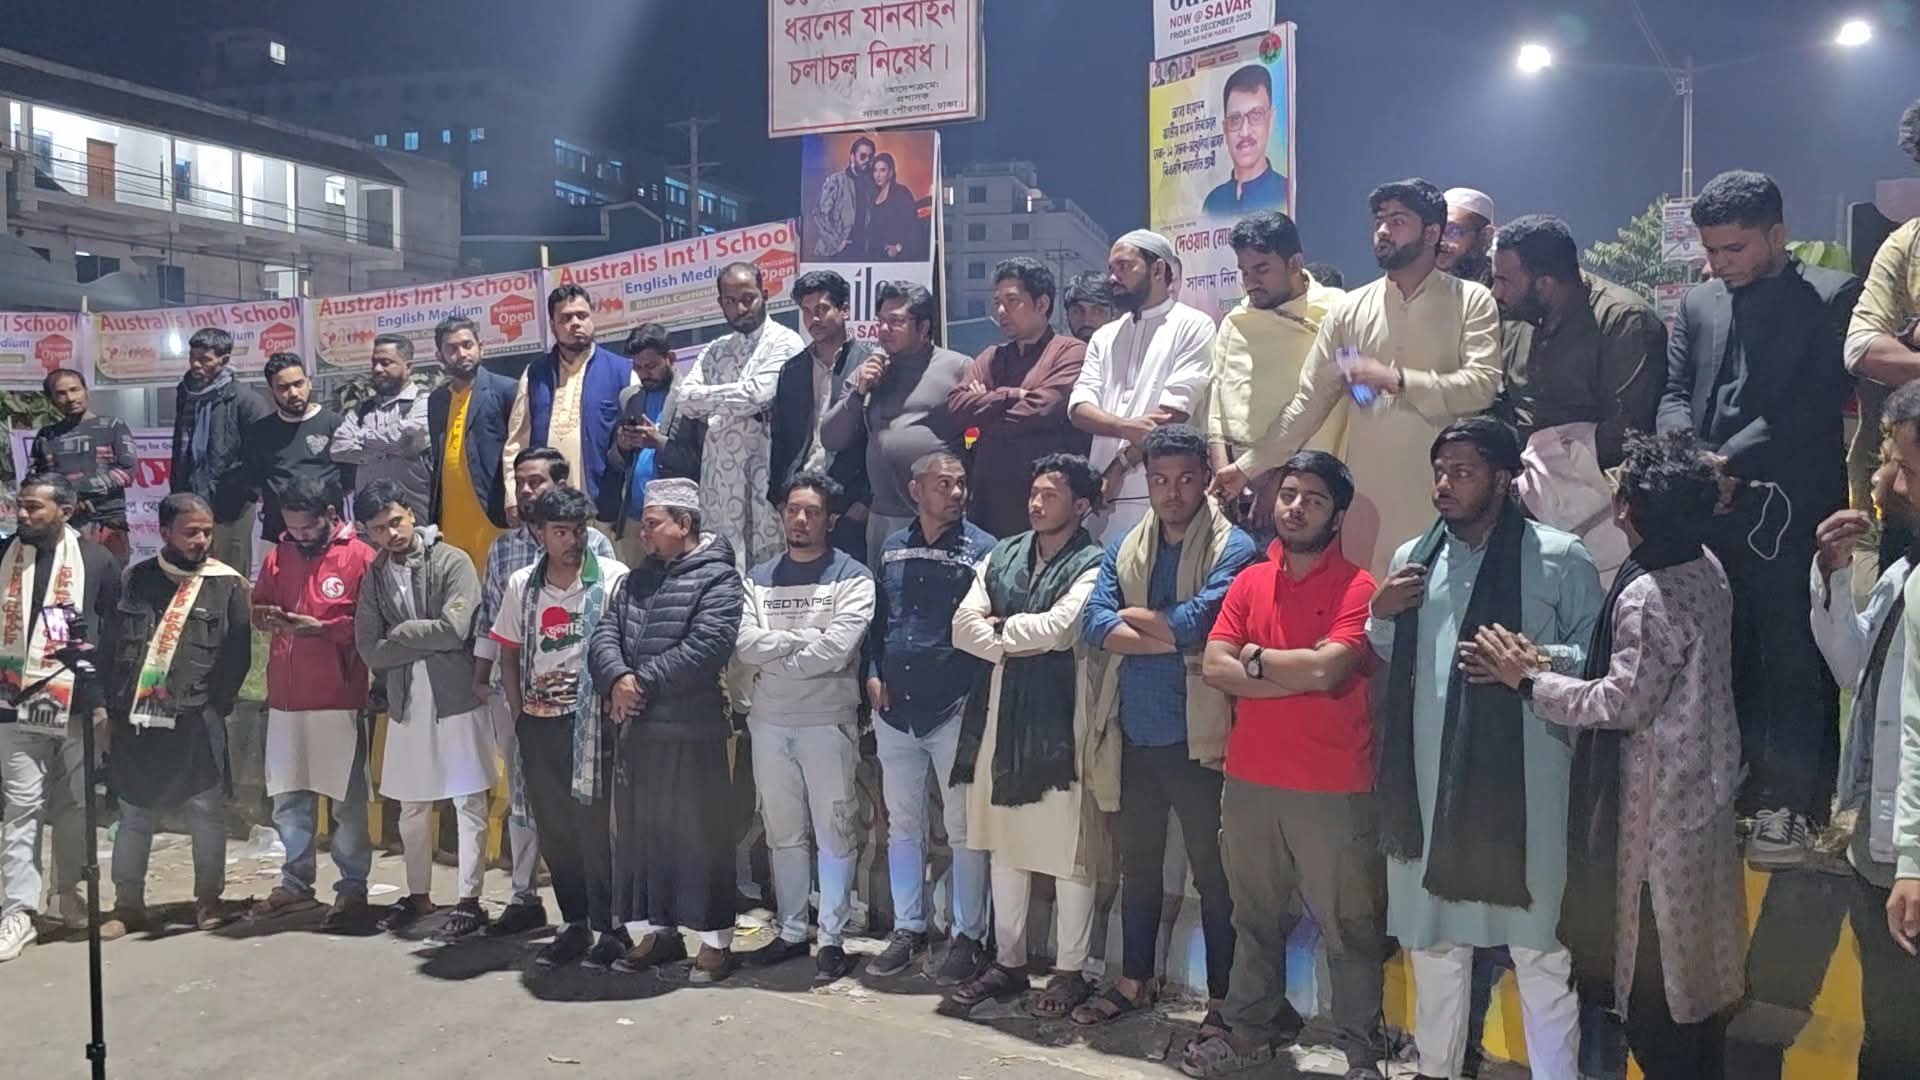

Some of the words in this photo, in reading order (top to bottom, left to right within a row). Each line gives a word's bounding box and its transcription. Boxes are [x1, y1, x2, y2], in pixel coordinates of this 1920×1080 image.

[783, 9, 854, 44] ধরনের
[861, 0, 956, 33] যানবাহন
[1169, 12, 1192, 30] NOW
[1194, 10, 1203, 23] @
[1205, 0, 1252, 20] SAVAR
[787, 53, 860, 86] চলাচল
[868, 40, 936, 79] নিষেধ
[559, 251, 658, 286] Australis
[664, 240, 708, 269] Int'l
[715, 221, 795, 258] School
[319, 289, 408, 316] Australis
[415, 282, 456, 306] Int'l
[462, 272, 533, 299] School
[625, 275, 678, 295] English
[682, 266, 720, 285] Medi
[1185, 274, 1217, 292] সালাম
[1220, 267, 1238, 288] নিন
[13, 314, 74, 333] School
[101, 310, 185, 332] Australis
[189, 306, 228, 328] Int'l
[231, 301, 296, 324] School
[378, 309, 425, 329] English
[429, 304, 483, 322] Medium
[499, 311, 533, 326] Open
[0, 337, 30, 348] dium
[763, 595, 833, 609] REDTAPE
